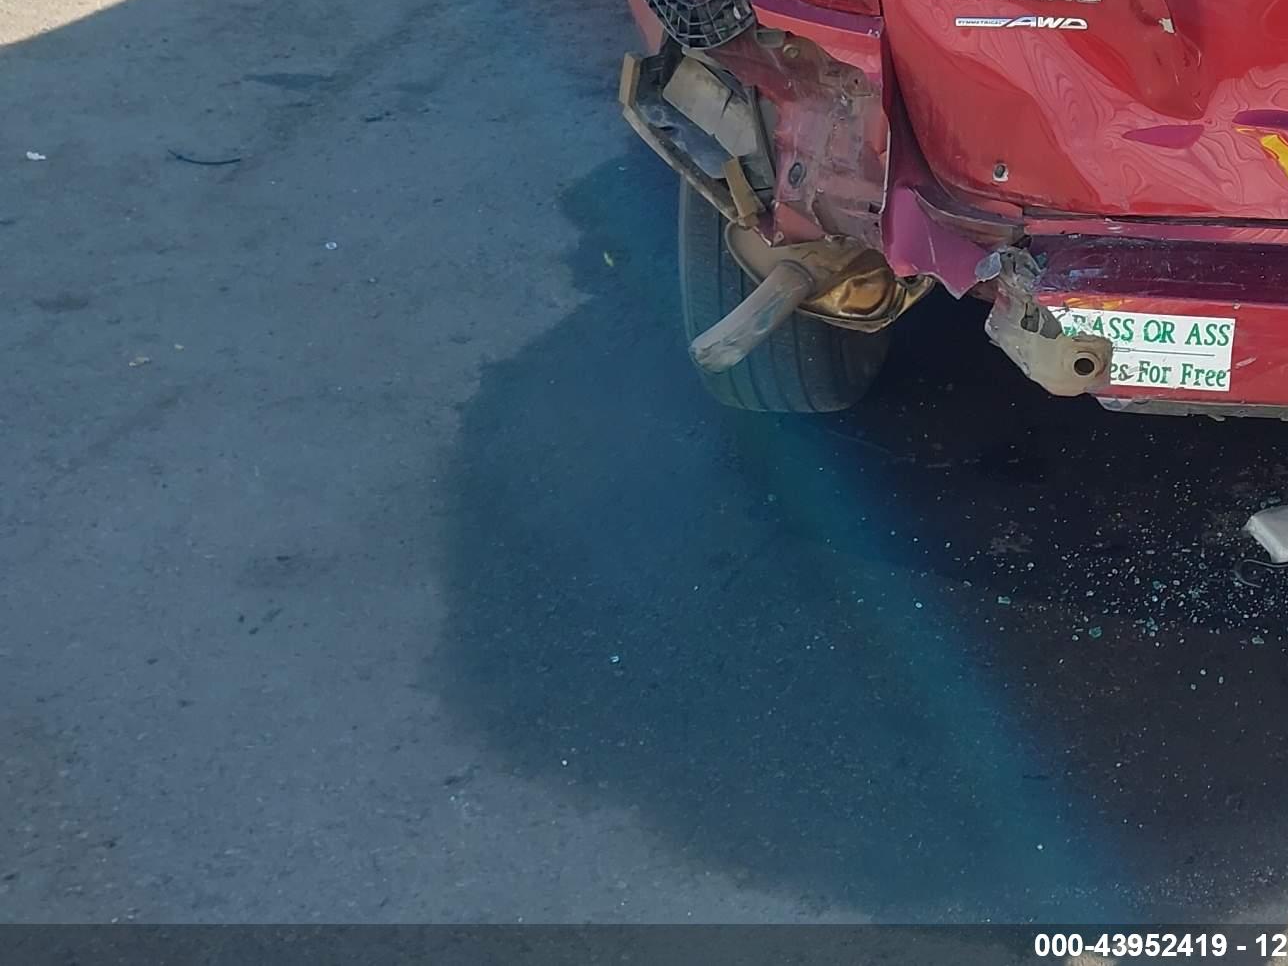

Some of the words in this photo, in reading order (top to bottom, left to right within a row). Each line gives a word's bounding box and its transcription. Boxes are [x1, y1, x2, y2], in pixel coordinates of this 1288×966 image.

[1006, 17, 1089, 30] AWD
[1143, 319, 1176, 344] OR
[1184, 323, 1232, 347] ASS
[1137, 361, 1172, 385] For
[1179, 363, 1228, 388] Free
